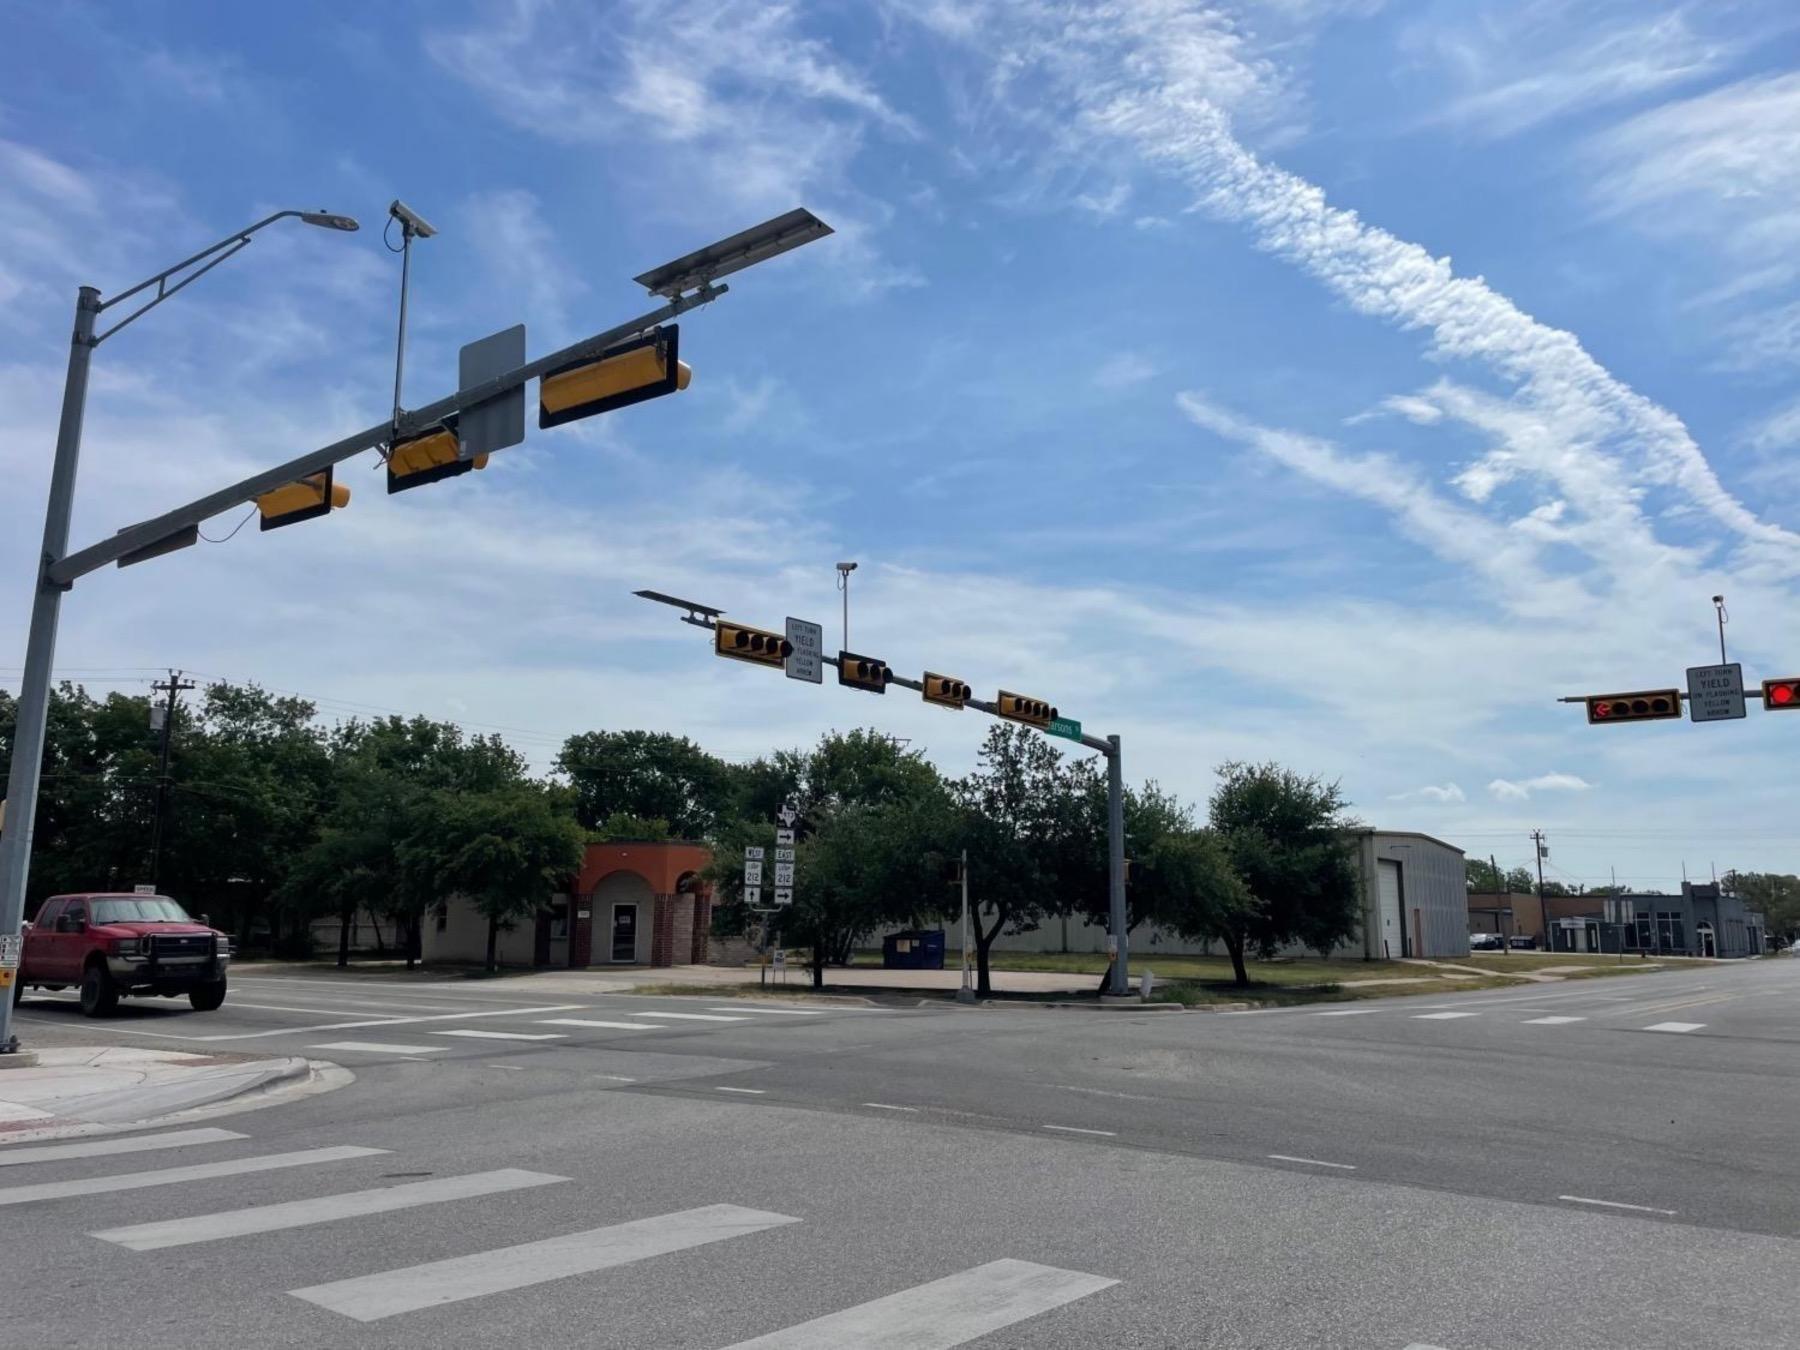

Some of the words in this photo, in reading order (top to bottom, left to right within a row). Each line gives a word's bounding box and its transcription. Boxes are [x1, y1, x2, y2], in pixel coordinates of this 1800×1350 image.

[795, 634, 814, 648] YIELD
[1701, 678, 1730, 689] YIELD
[778, 850, 792, 859] EAST
[746, 872, 759, 882] 212
[777, 874, 791, 883] 212
